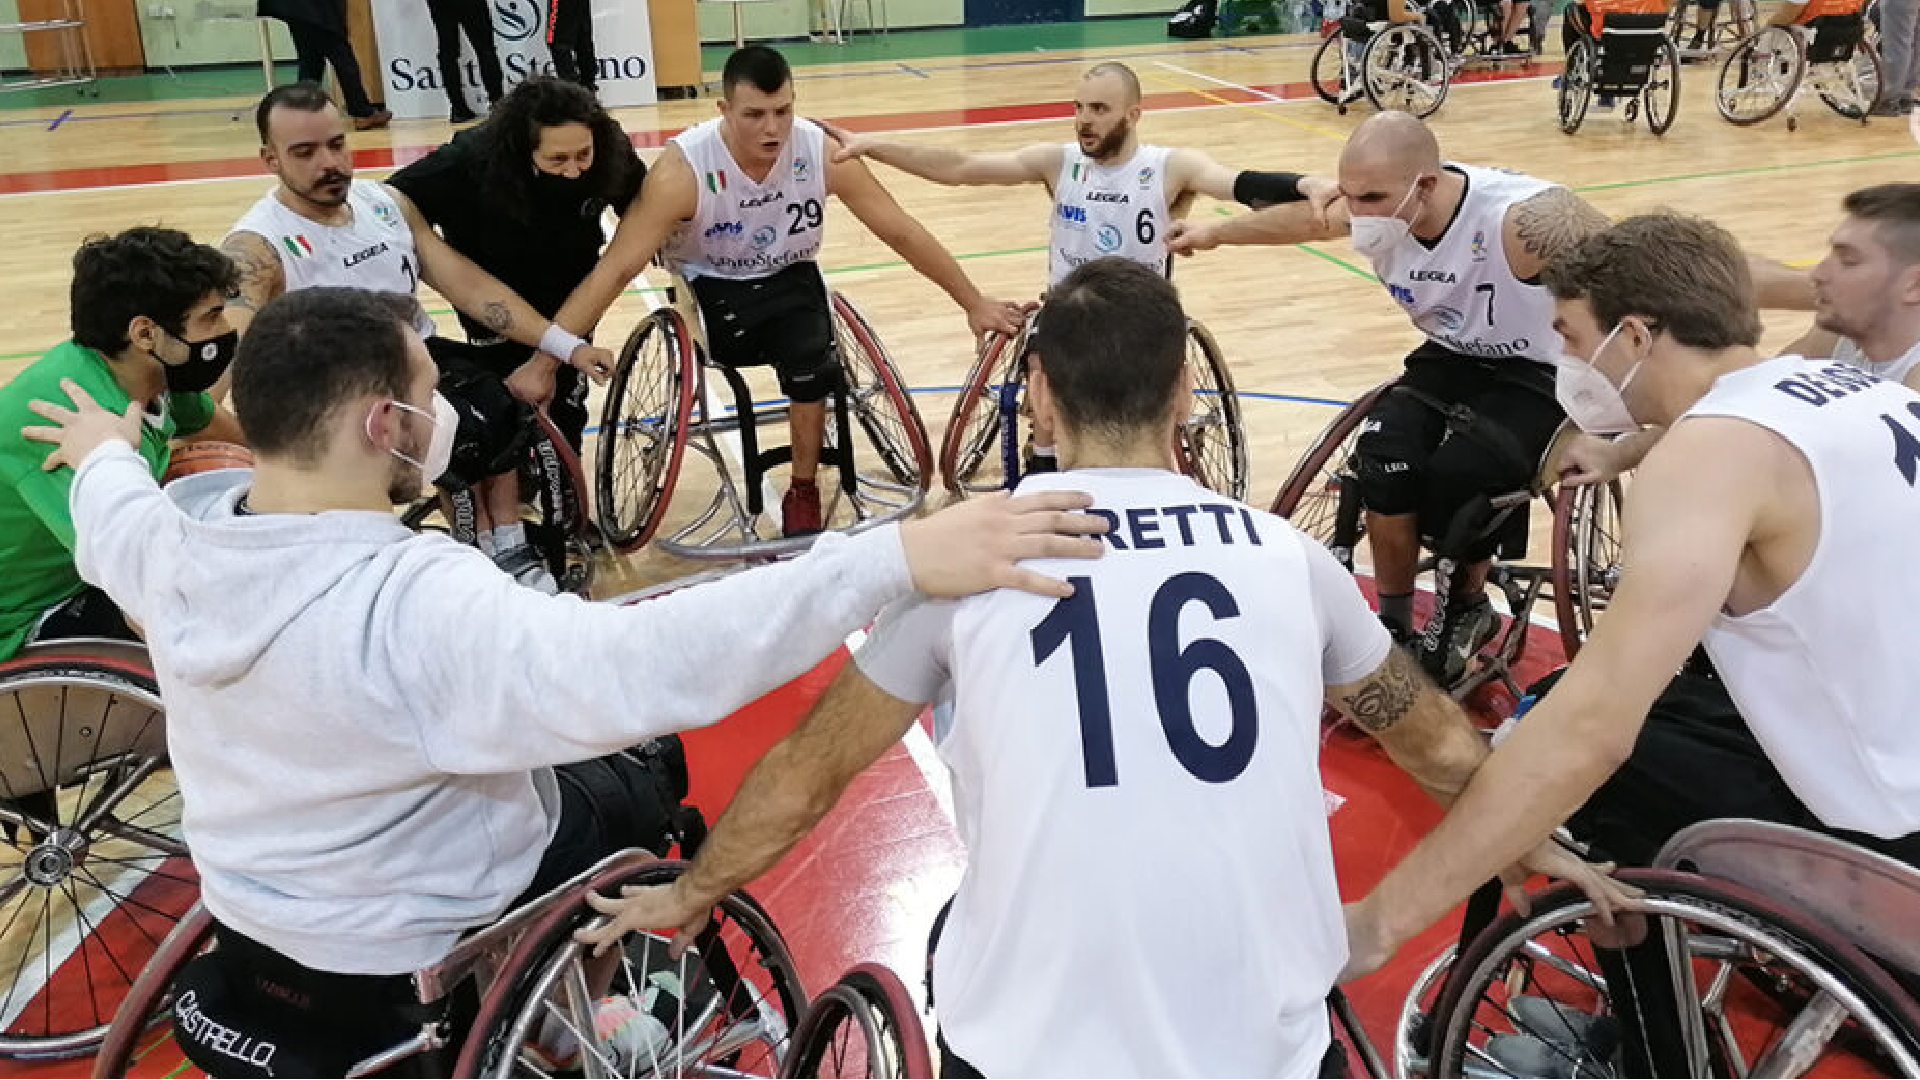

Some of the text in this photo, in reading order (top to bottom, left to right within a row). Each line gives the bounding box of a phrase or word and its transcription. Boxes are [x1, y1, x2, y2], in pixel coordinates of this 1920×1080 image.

[786, 198, 823, 236] 29
[1135, 207, 1155, 244] 6
[1475, 282, 1496, 326] 7
[1084, 502, 1262, 551] RETTI
[1029, 570, 1260, 788] 16
